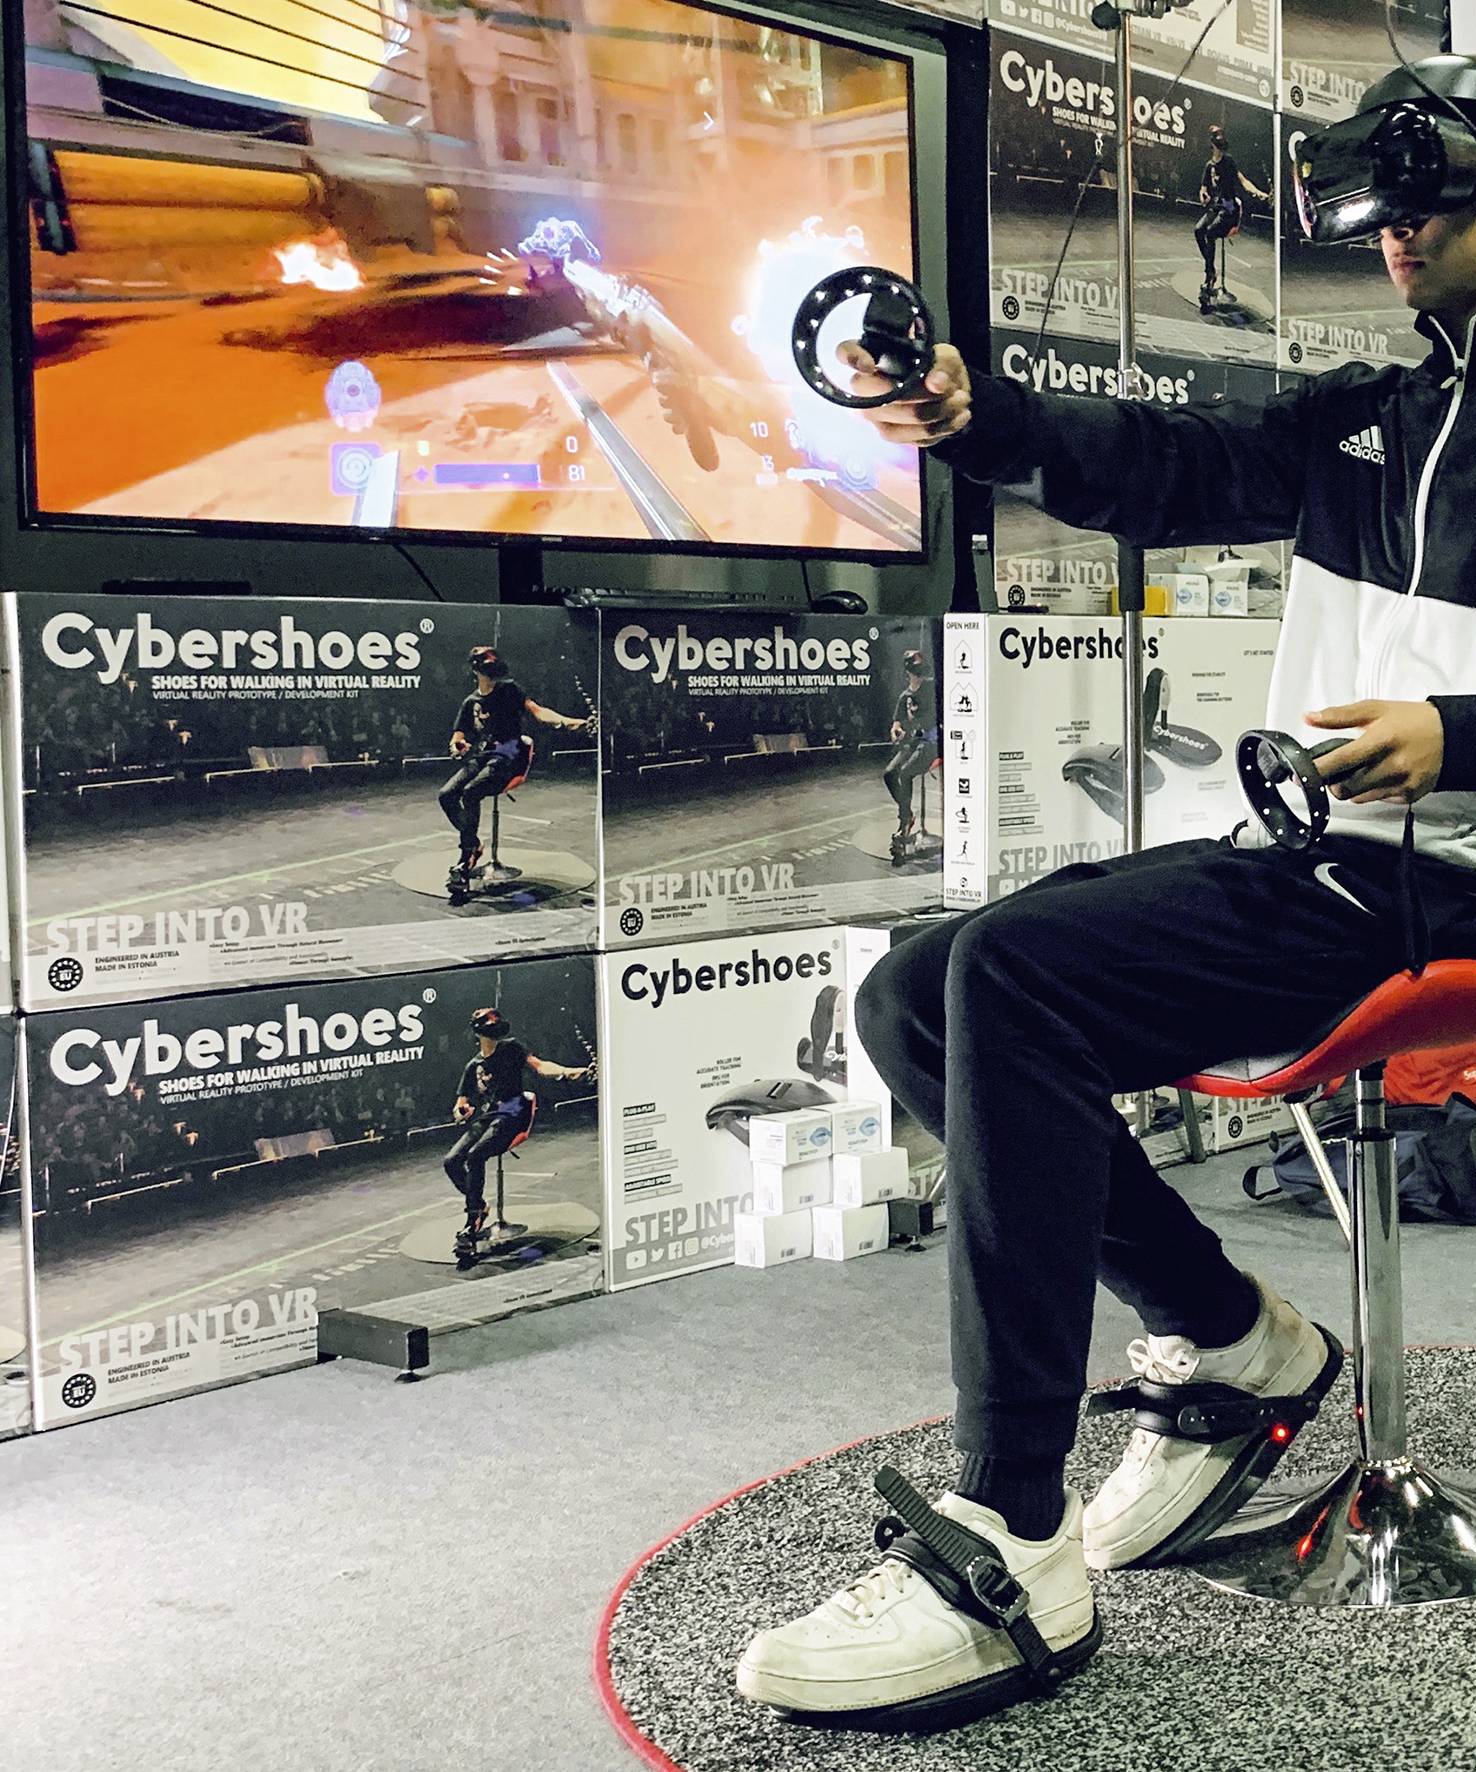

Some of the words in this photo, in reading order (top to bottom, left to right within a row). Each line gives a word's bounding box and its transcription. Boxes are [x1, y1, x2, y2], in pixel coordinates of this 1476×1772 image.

[1000, 50, 1186, 134] Cybersoes
[1001, 269, 1049, 297] STEP
[1053, 276, 1100, 306] INTO
[1288, 319, 1325, 341] STEP
[1328, 325, 1365, 350] INTO
[1369, 331, 1388, 355] VR
[1339, 440, 1385, 465] adidas
[1006, 558, 1055, 583] STEP
[1059, 559, 1107, 585] INTO
[999, 626, 1158, 669] Cybershs
[152, 675, 198, 689] SHOES
[200, 675, 228, 689] FOR
[230, 674, 296, 689] WALKING
[298, 674, 313, 689] IN
[315, 674, 369, 689] VIRTUAL
[371, 674, 421, 689] REALITY
[152, 690, 190, 700] VIRTUAL
[192, 690, 232, 700] REALITY
[235, 690, 277, 700] PROTOTYPE
[285, 690, 343, 700] DEVELOPMENT
[346, 690, 359, 699] KIT
[688, 675, 719, 688] SHOES
[720, 675, 739, 687] FOR
[741, 675, 784, 687] WALKING
[786, 674, 797, 686] IN
[799, 674, 835, 686] VIRTUAL
[836, 674, 870, 686] REALITY
[999, 846, 1047, 874] STEP
[1053, 841, 1100, 869] INTO
[620, 873, 683, 904] STEP
[690, 866, 755, 898] INTO
[760, 862, 794, 892] VR
[46, 914, 144, 952] STEP
[155, 905, 250, 945] INTO
[258, 901, 307, 938] VR
[621, 949, 832, 1008] Cybershoes
[159, 1075, 205, 1094] SHOES
[207, 1071, 235, 1088] FOR
[236, 1062, 301, 1084] WALKING
[302, 1060, 318, 1074] IN
[320, 1054, 374, 1071] VIRTUAL
[375, 1046, 424, 1064] REALITY
[160, 1092, 197, 1104] VIRTUAL
[199, 1088, 233, 1100] REALITY
[234, 1081, 283, 1095] PROTOTYPE
[291, 1071, 350, 1087] DEVELOPMENT
[351, 1069, 363, 1078] KIT
[625, 1207, 688, 1243] STEP
[60, 1321, 155, 1370] STEP
[165, 1299, 260, 1350] INTO
[268, 1286, 318, 1328] VR
[140, 1365, 169, 1377] ESTONIA
